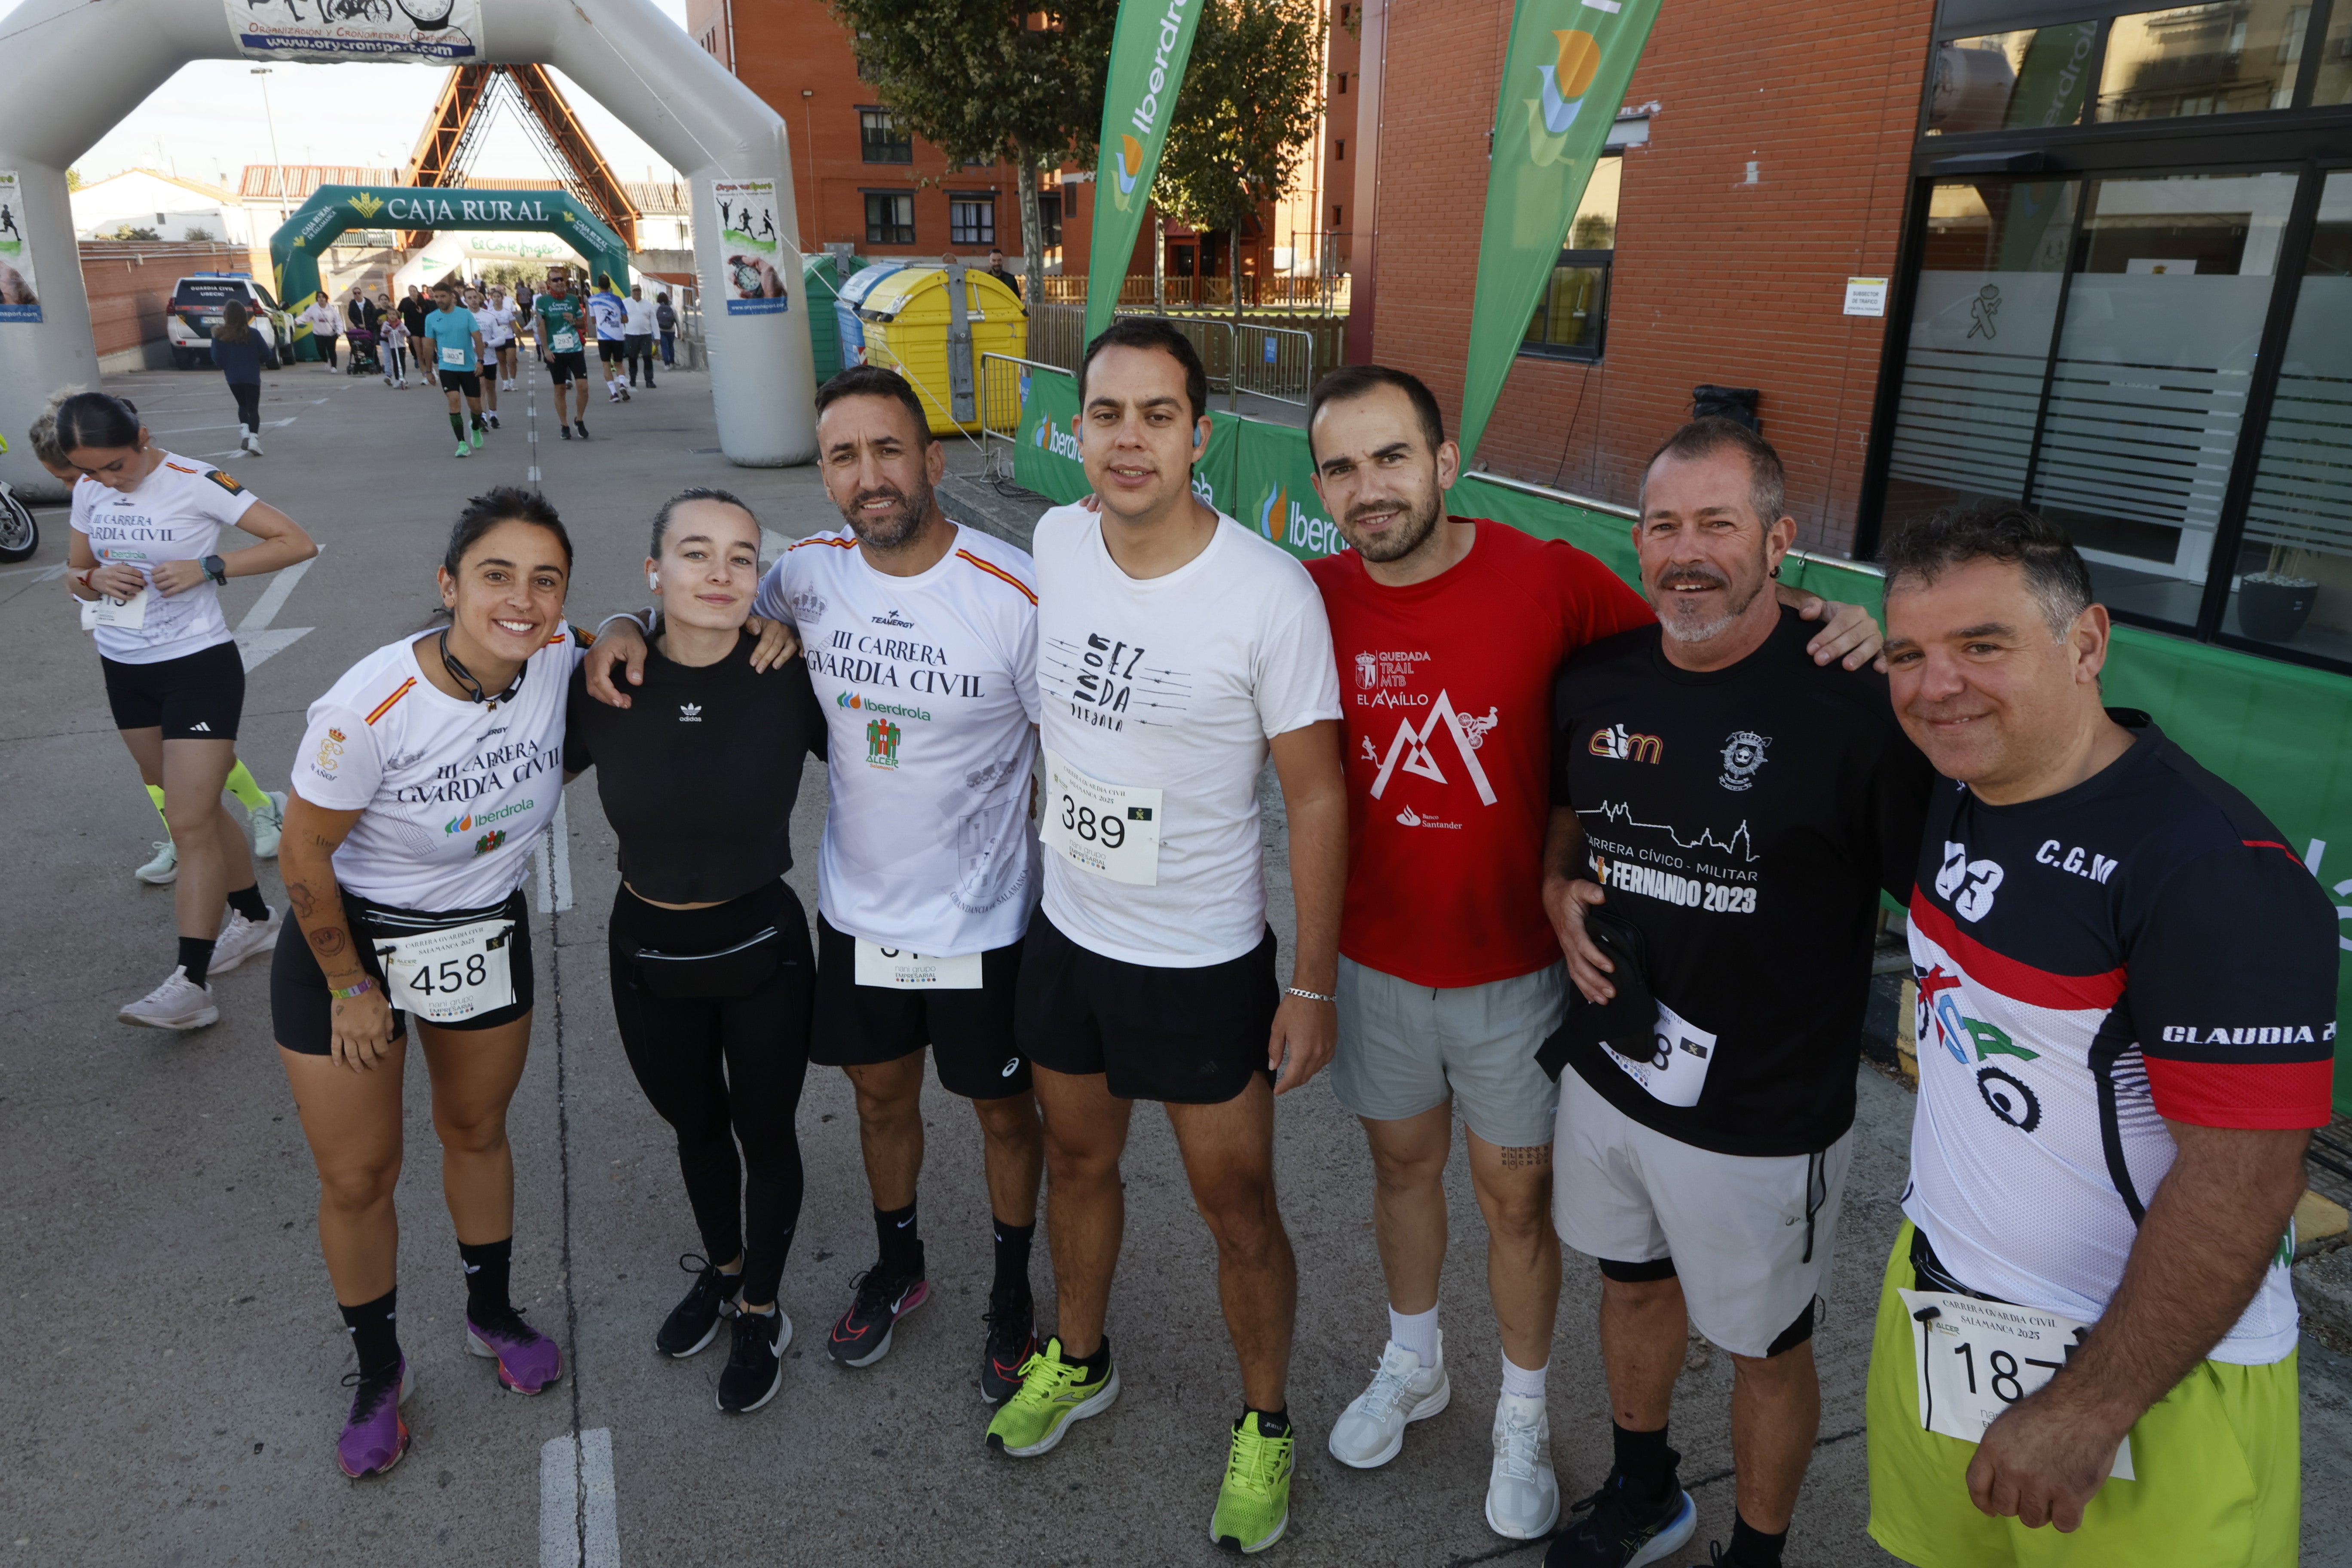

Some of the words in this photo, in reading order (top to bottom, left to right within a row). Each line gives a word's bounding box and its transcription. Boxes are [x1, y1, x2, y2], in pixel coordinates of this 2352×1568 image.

[266, 38, 453, 56] www.orycronsport.com
[388, 199, 456, 225] CAJA
[461, 200, 549, 221] RURAL
[472, 236, 484, 250] El
[486, 242, 518, 253] Corte
[519, 237, 563, 258] Inglés
[104, 515, 152, 527] CARRERA
[132, 529, 176, 541] CIVIL
[110, 550, 147, 559] Iberdrola
[832, 630, 854, 649] III
[858, 636, 948, 666] CARRERA
[1379, 650, 1431, 662] QUEDADA
[806, 650, 900, 688] GVARDIA
[910, 670, 985, 698] CIVIL
[1380, 662, 1414, 674] TRAIL
[1380, 675, 1407, 687] MTB
[1357, 694, 1369, 705] EL
[1371, 688, 1429, 710] MAÍLLO
[864, 697, 931, 722] Iberdrola
[512, 746, 560, 783] CIVIL
[866, 755, 899, 768] ALCER
[438, 763, 457, 779] III
[1099, 796, 1114, 804] 2025
[475, 797, 534, 827] Iberdrola
[1062, 794, 1125, 848] 389
[1422, 821, 1462, 830] Santander
[1069, 839, 1082, 851] nani
[1084, 846, 1106, 860] grupo
[1069, 846, 1106, 866] EMPRESARIAL
[1639, 848, 1683, 869] CÍVICO
[1697, 863, 1758, 881] MILITAR
[997, 869, 1029, 905] SALAMANCA
[1612, 860, 1702, 907] FERNANDO
[1703, 882, 1758, 913] 2023
[460, 938, 475, 946] 2025
[410, 953, 486, 995] 458
[913, 965, 936, 974] grupo
[429, 999, 447, 1008] nani
[450, 995, 474, 1007] grupo
[429, 1002, 474, 1014] EMPRESARIAL
[2162, 1026, 2315, 1044] CLAUDIA
[1942, 1299, 1984, 1315] CARRERA
[1936, 1322, 1960, 1335] ALCER
[1961, 1315, 2015, 1335] SALAMANCA
[2017, 1328, 2040, 1340] 2025
